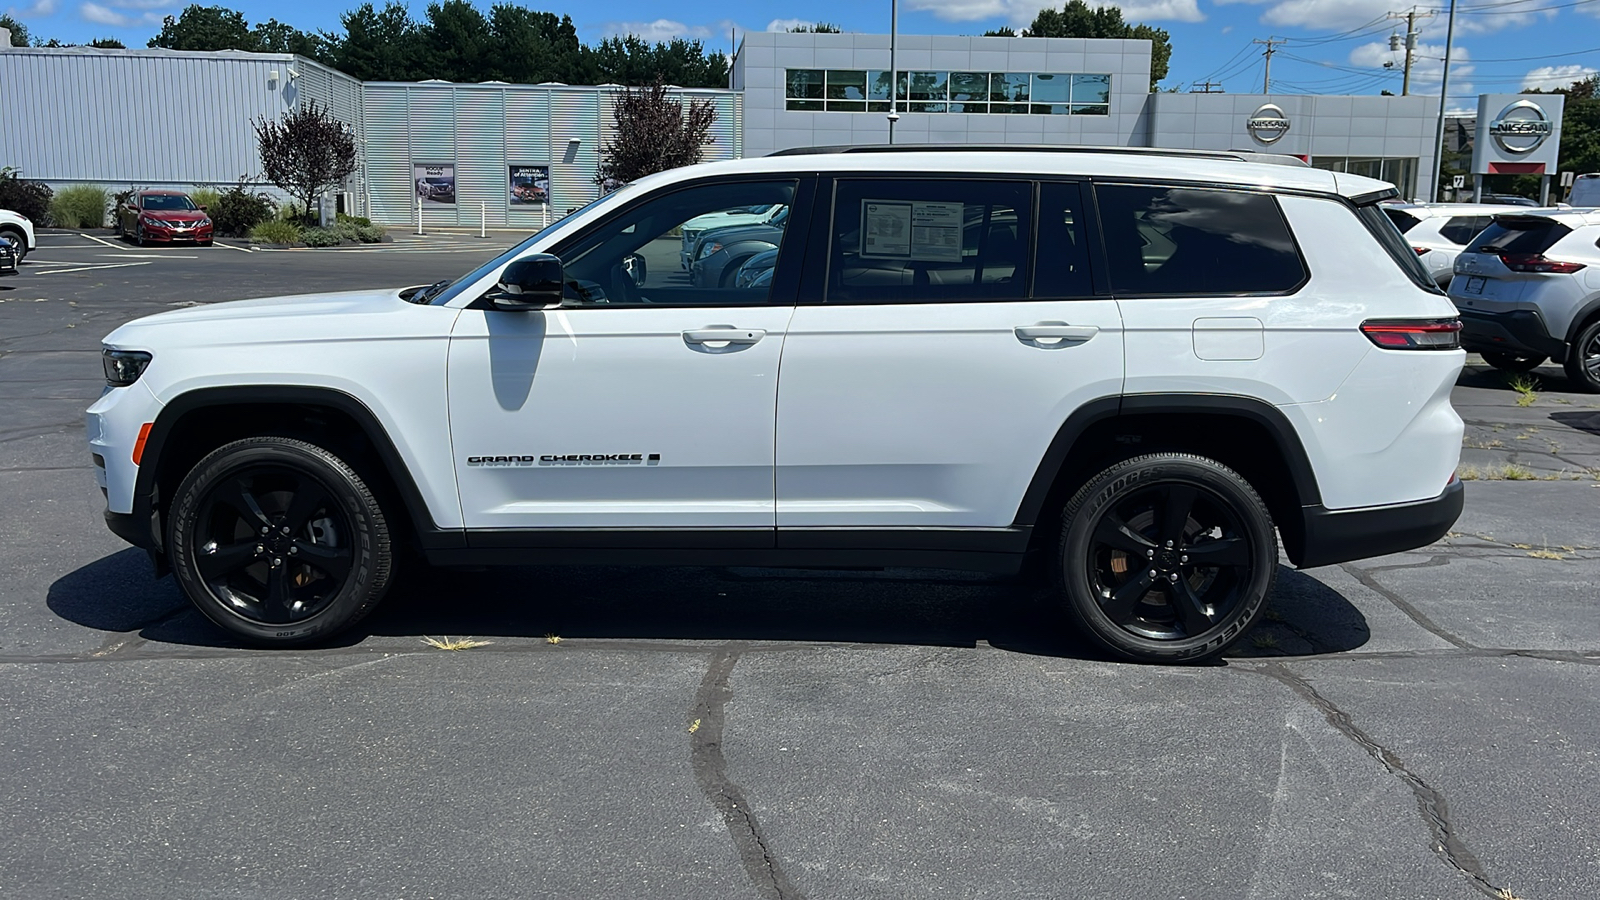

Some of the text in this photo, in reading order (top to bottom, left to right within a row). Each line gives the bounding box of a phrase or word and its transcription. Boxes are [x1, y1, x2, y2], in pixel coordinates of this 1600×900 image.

[1497, 123, 1548, 132] NISSAN
[467, 455, 534, 463] GRAND
[539, 454, 643, 462] CHEROKEE
[349, 496, 371, 600] DUELER
[1175, 591, 1262, 658] DUELER
